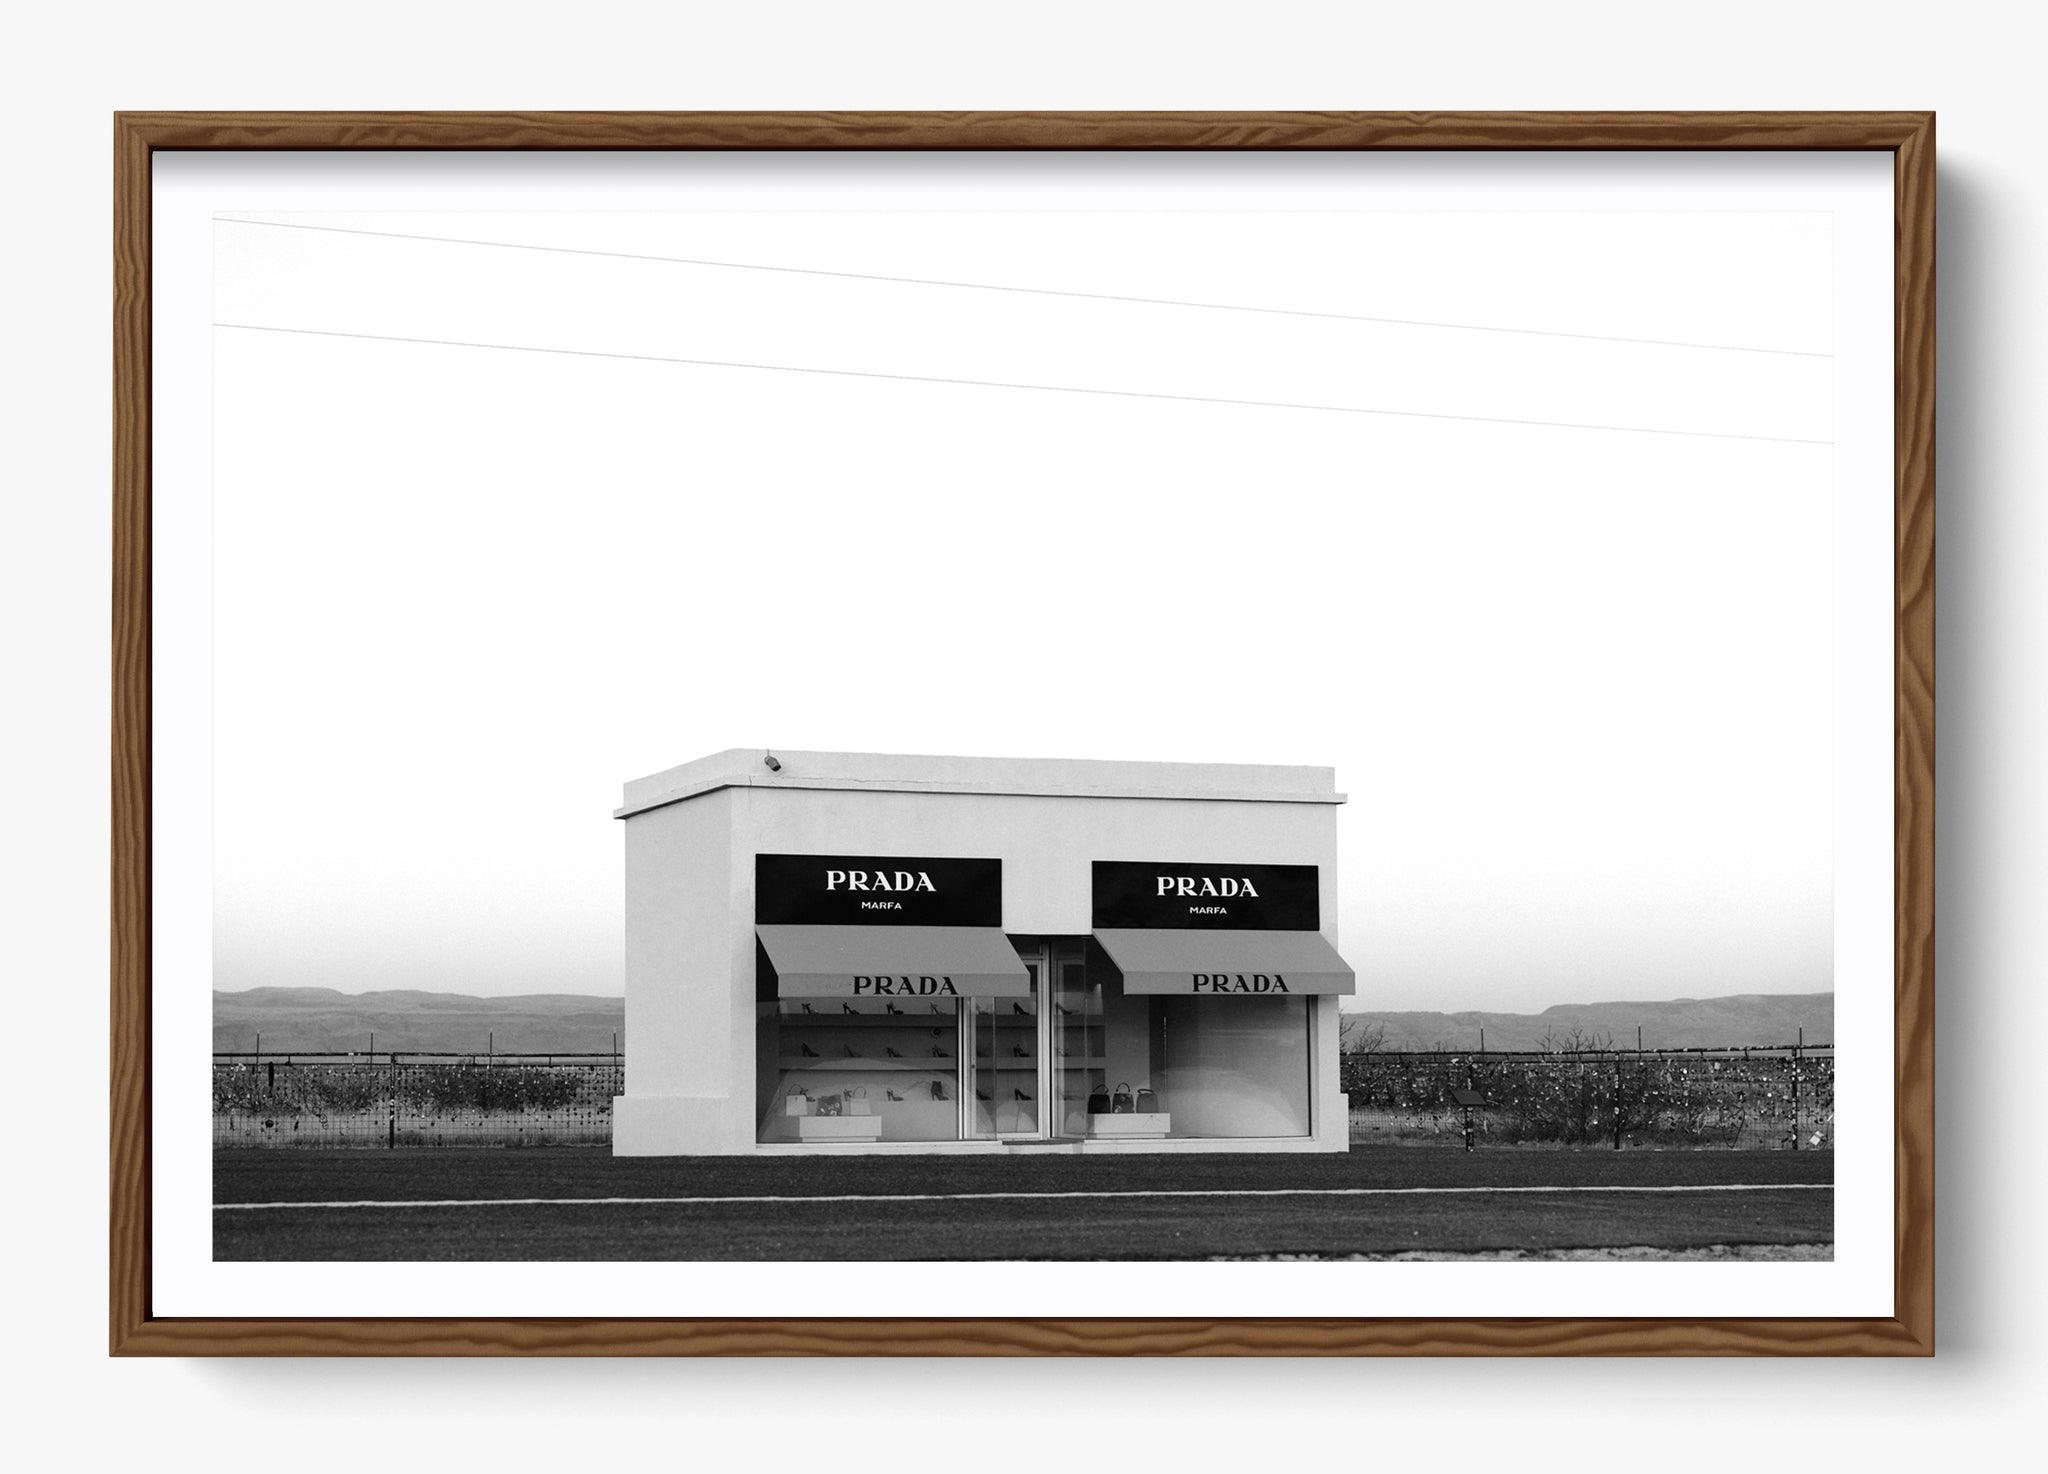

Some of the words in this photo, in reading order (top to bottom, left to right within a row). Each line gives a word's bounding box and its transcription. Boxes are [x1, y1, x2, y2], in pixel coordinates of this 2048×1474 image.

[826, 870, 937, 892] PRADA
[1156, 876, 1259, 898] PRADA
[861, 901, 903, 910] MARFA
[1189, 906, 1228, 915] MARFA
[852, 975, 959, 996] PRADA
[1191, 973, 1290, 994] PRADA
